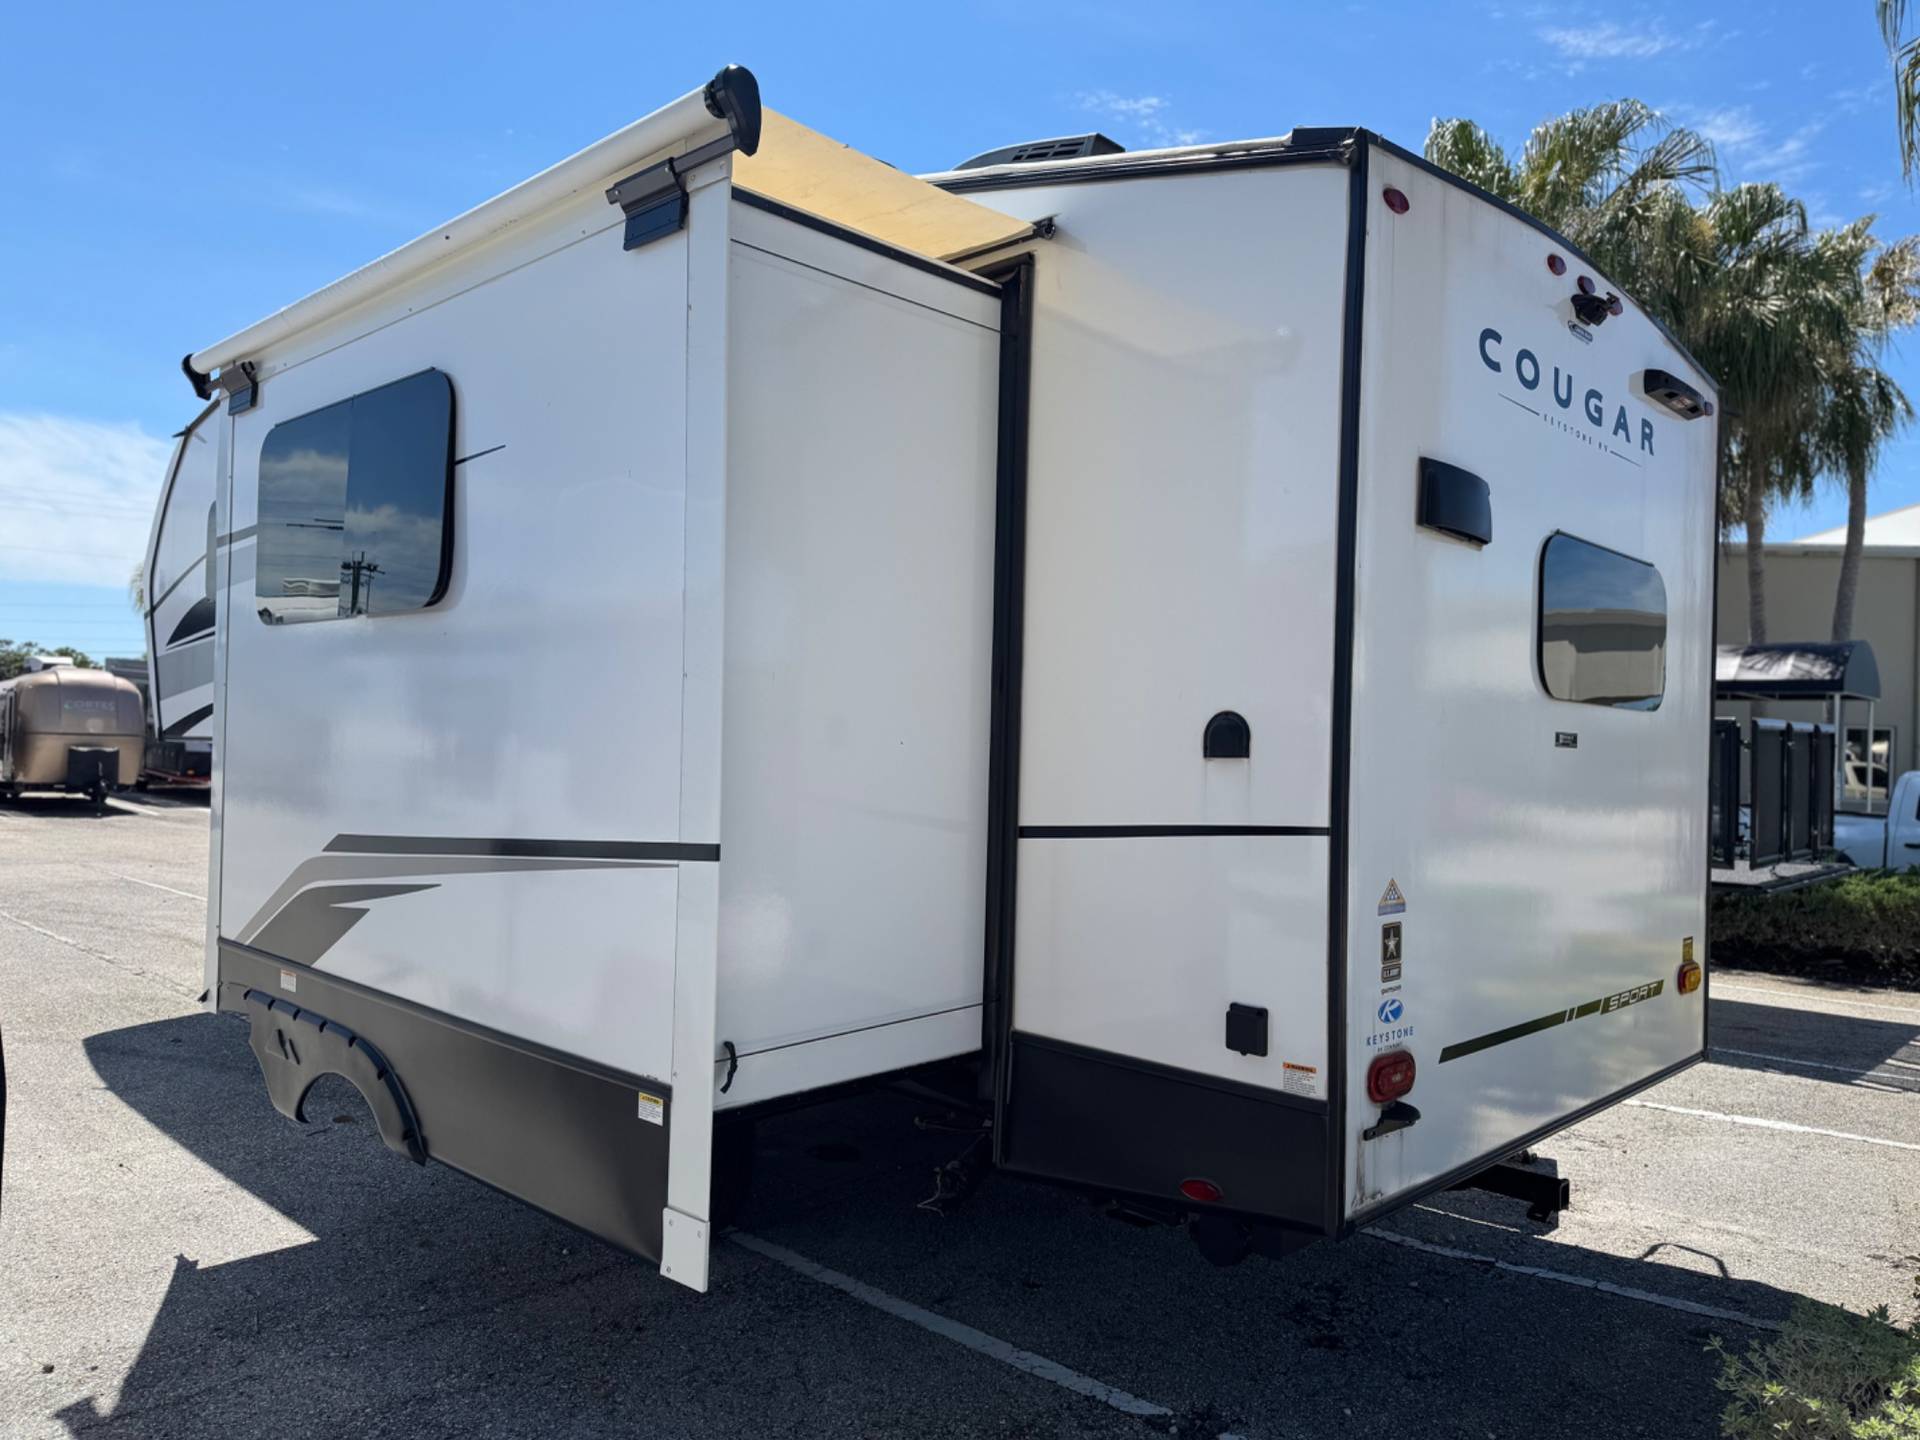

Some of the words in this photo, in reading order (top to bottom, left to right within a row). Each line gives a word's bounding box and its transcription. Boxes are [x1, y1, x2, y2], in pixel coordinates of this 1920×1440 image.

[1478, 327, 1655, 456] COUGAR
[1608, 982, 1659, 1011] SPORT
[1365, 1025, 1415, 1046] KEYSTONE
